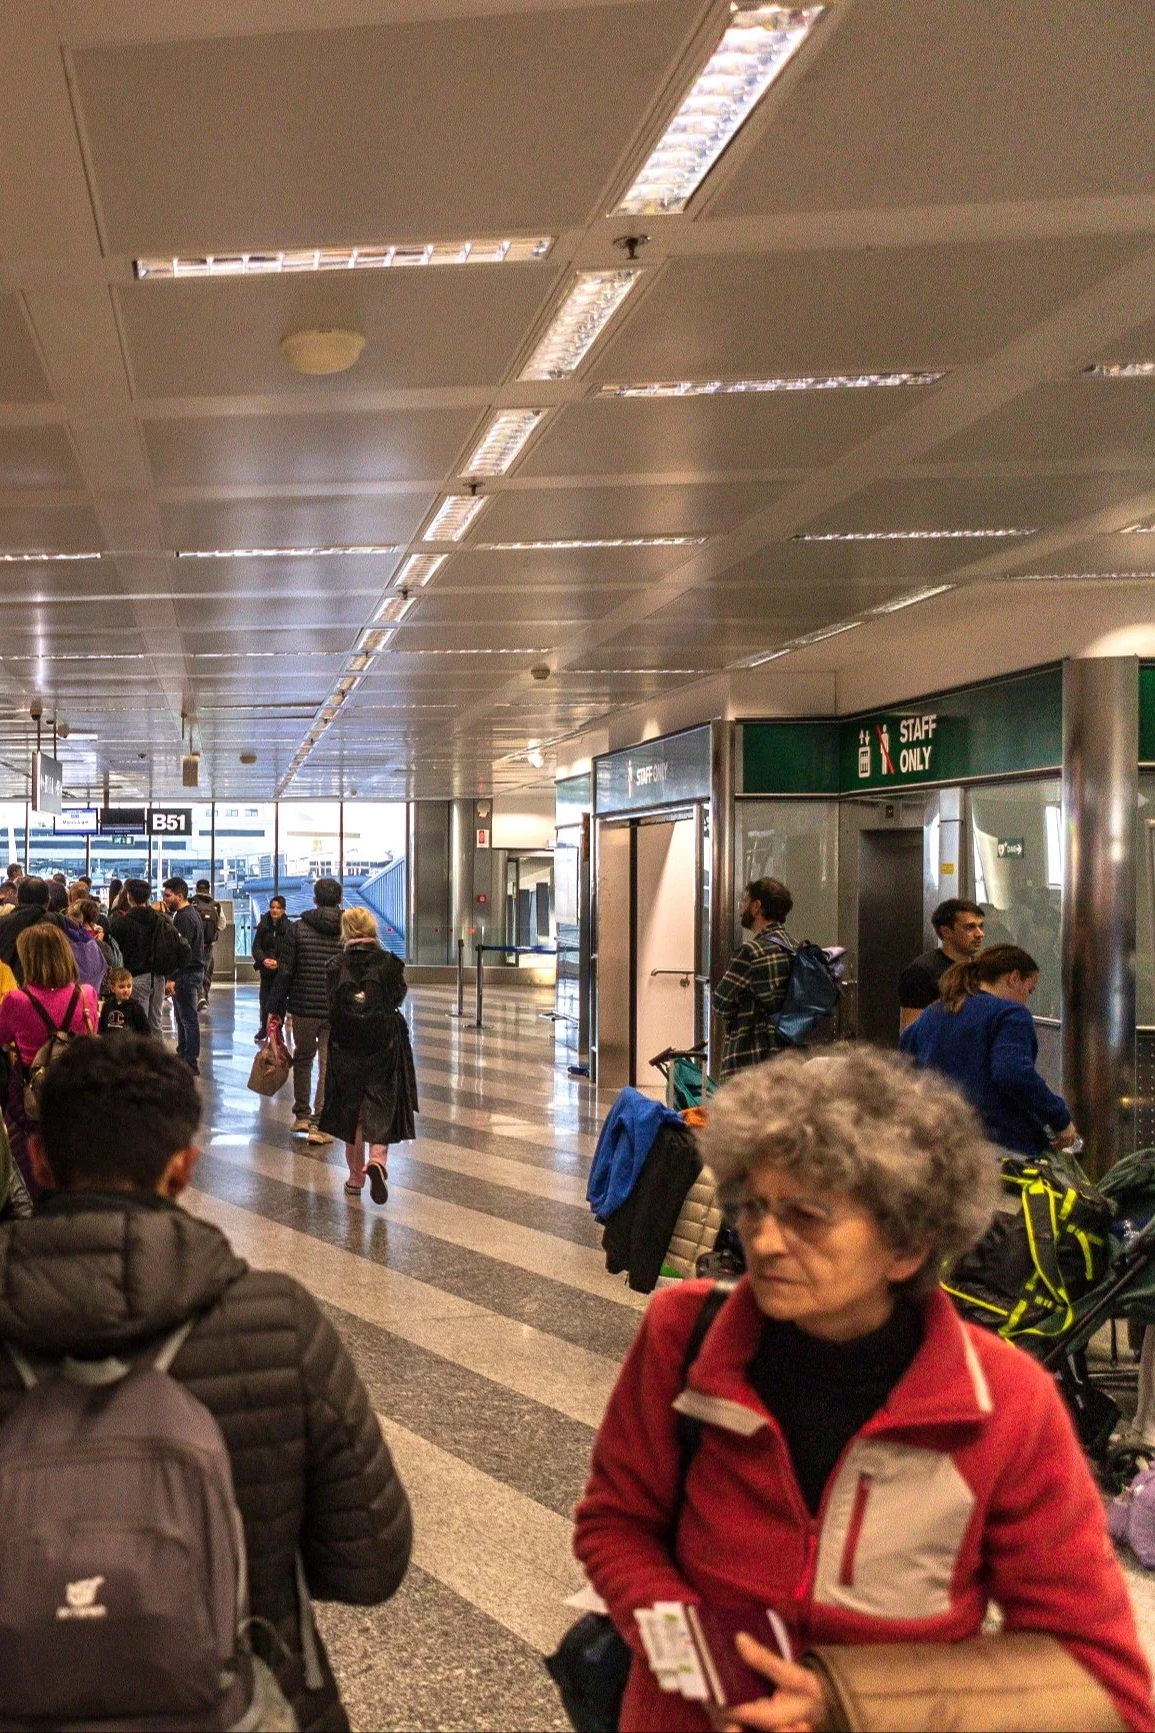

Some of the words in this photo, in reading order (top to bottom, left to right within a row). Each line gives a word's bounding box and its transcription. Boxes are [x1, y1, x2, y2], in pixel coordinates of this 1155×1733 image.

[899, 714, 937, 743] STAFF
[899, 746, 932, 773] ONLY
[636, 765, 653, 787] STAFF
[652, 761, 669, 782] ONLY
[152, 813, 186, 831] B51
